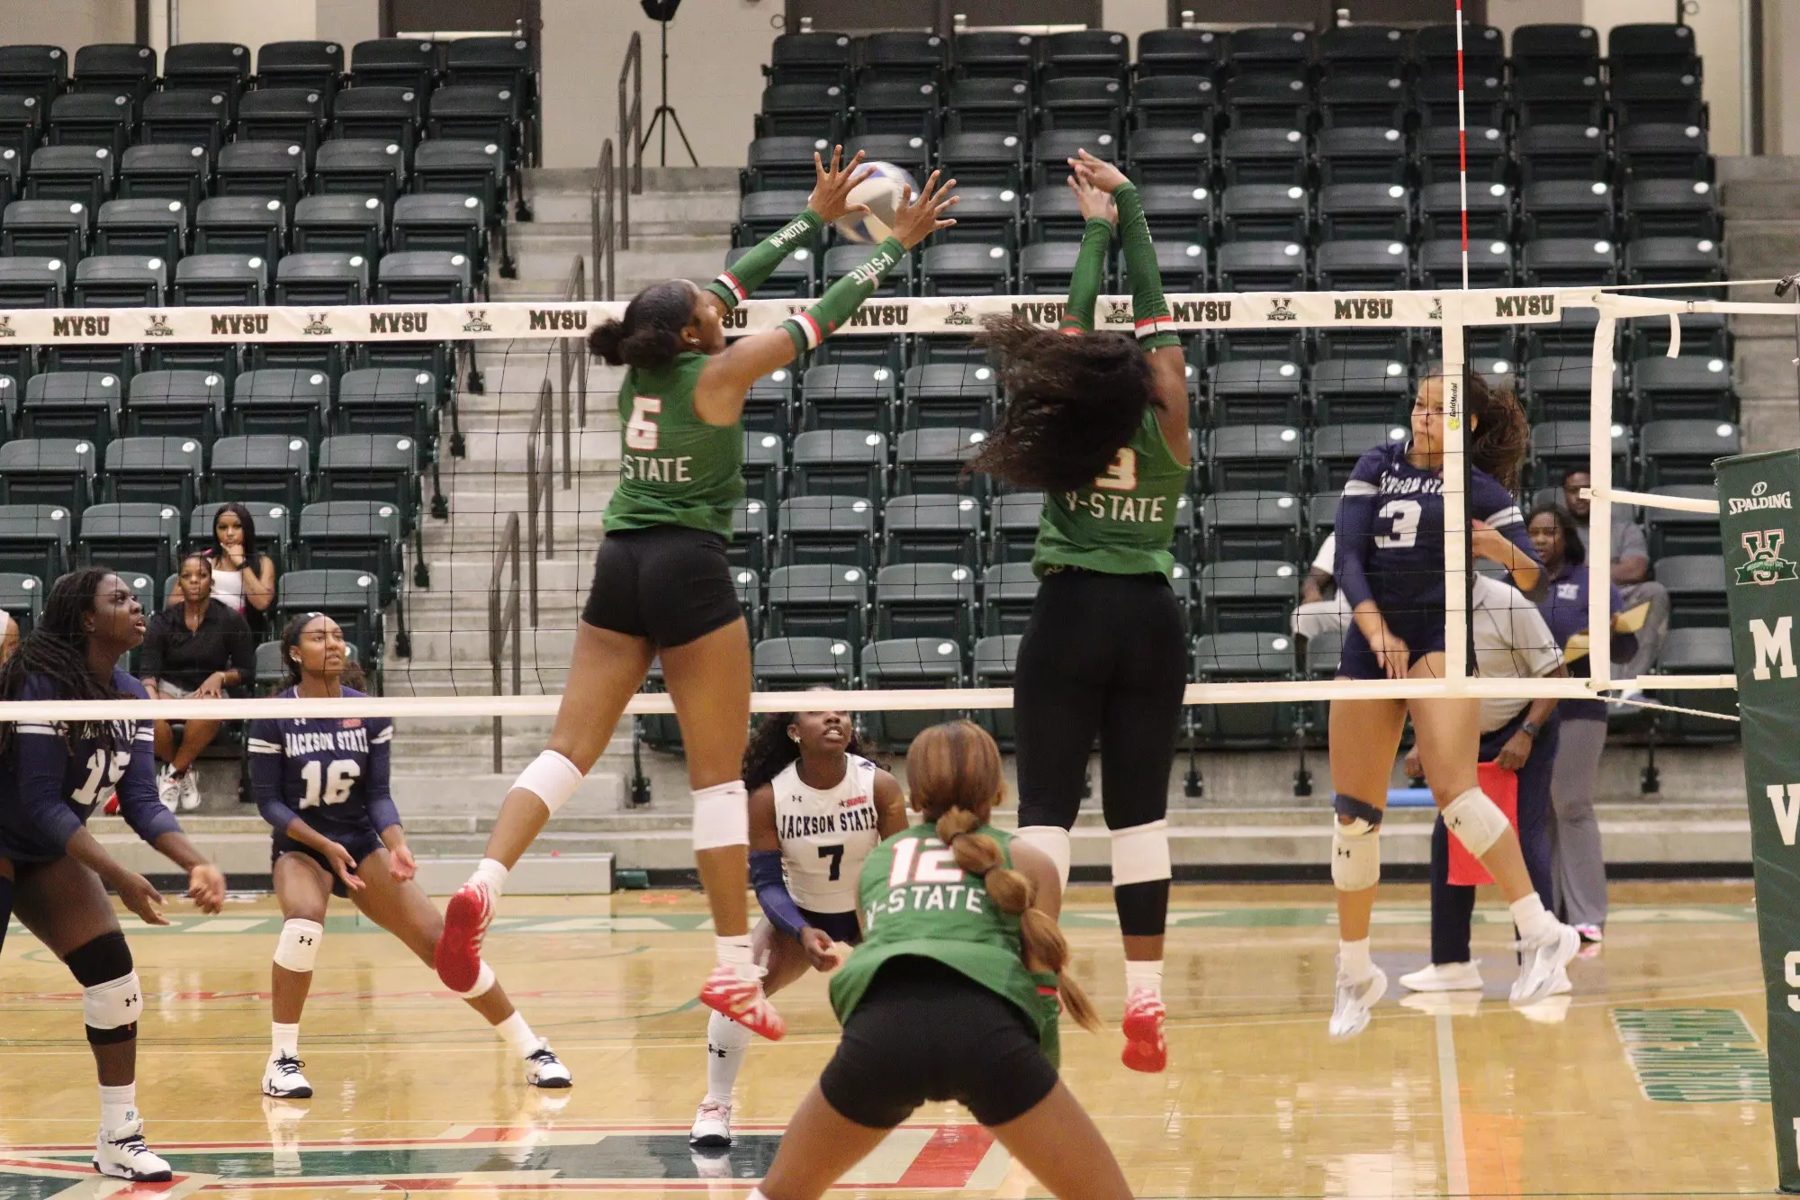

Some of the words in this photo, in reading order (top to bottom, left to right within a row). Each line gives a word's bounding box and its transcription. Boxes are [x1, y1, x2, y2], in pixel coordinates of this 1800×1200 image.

[53, 315, 110, 337] MVSU
[211, 313, 269, 335] MVSU
[370, 311, 428, 333] MVSU
[529, 309, 587, 331] MVSU
[721, 308, 748, 329] SU
[850, 305, 908, 327] MVSU
[1173, 301, 1232, 322] MVSU
[1334, 298, 1393, 320] MVSU
[1495, 294, 1555, 317] MVSU
[625, 395, 661, 451] 6
[1065, 489, 1167, 523] V-STATE
[1374, 499, 1422, 549] 3
[1727, 490, 1793, 515] SPALDING
[285, 731, 335, 758] JACKSON
[299, 759, 361, 809] 16
[780, 814, 835, 839] JACKSON
[839, 807, 877, 831] STATE
[817, 844, 844, 882] 7
[889, 836, 965, 888] 12
[866, 885, 986, 930] V-STATE
